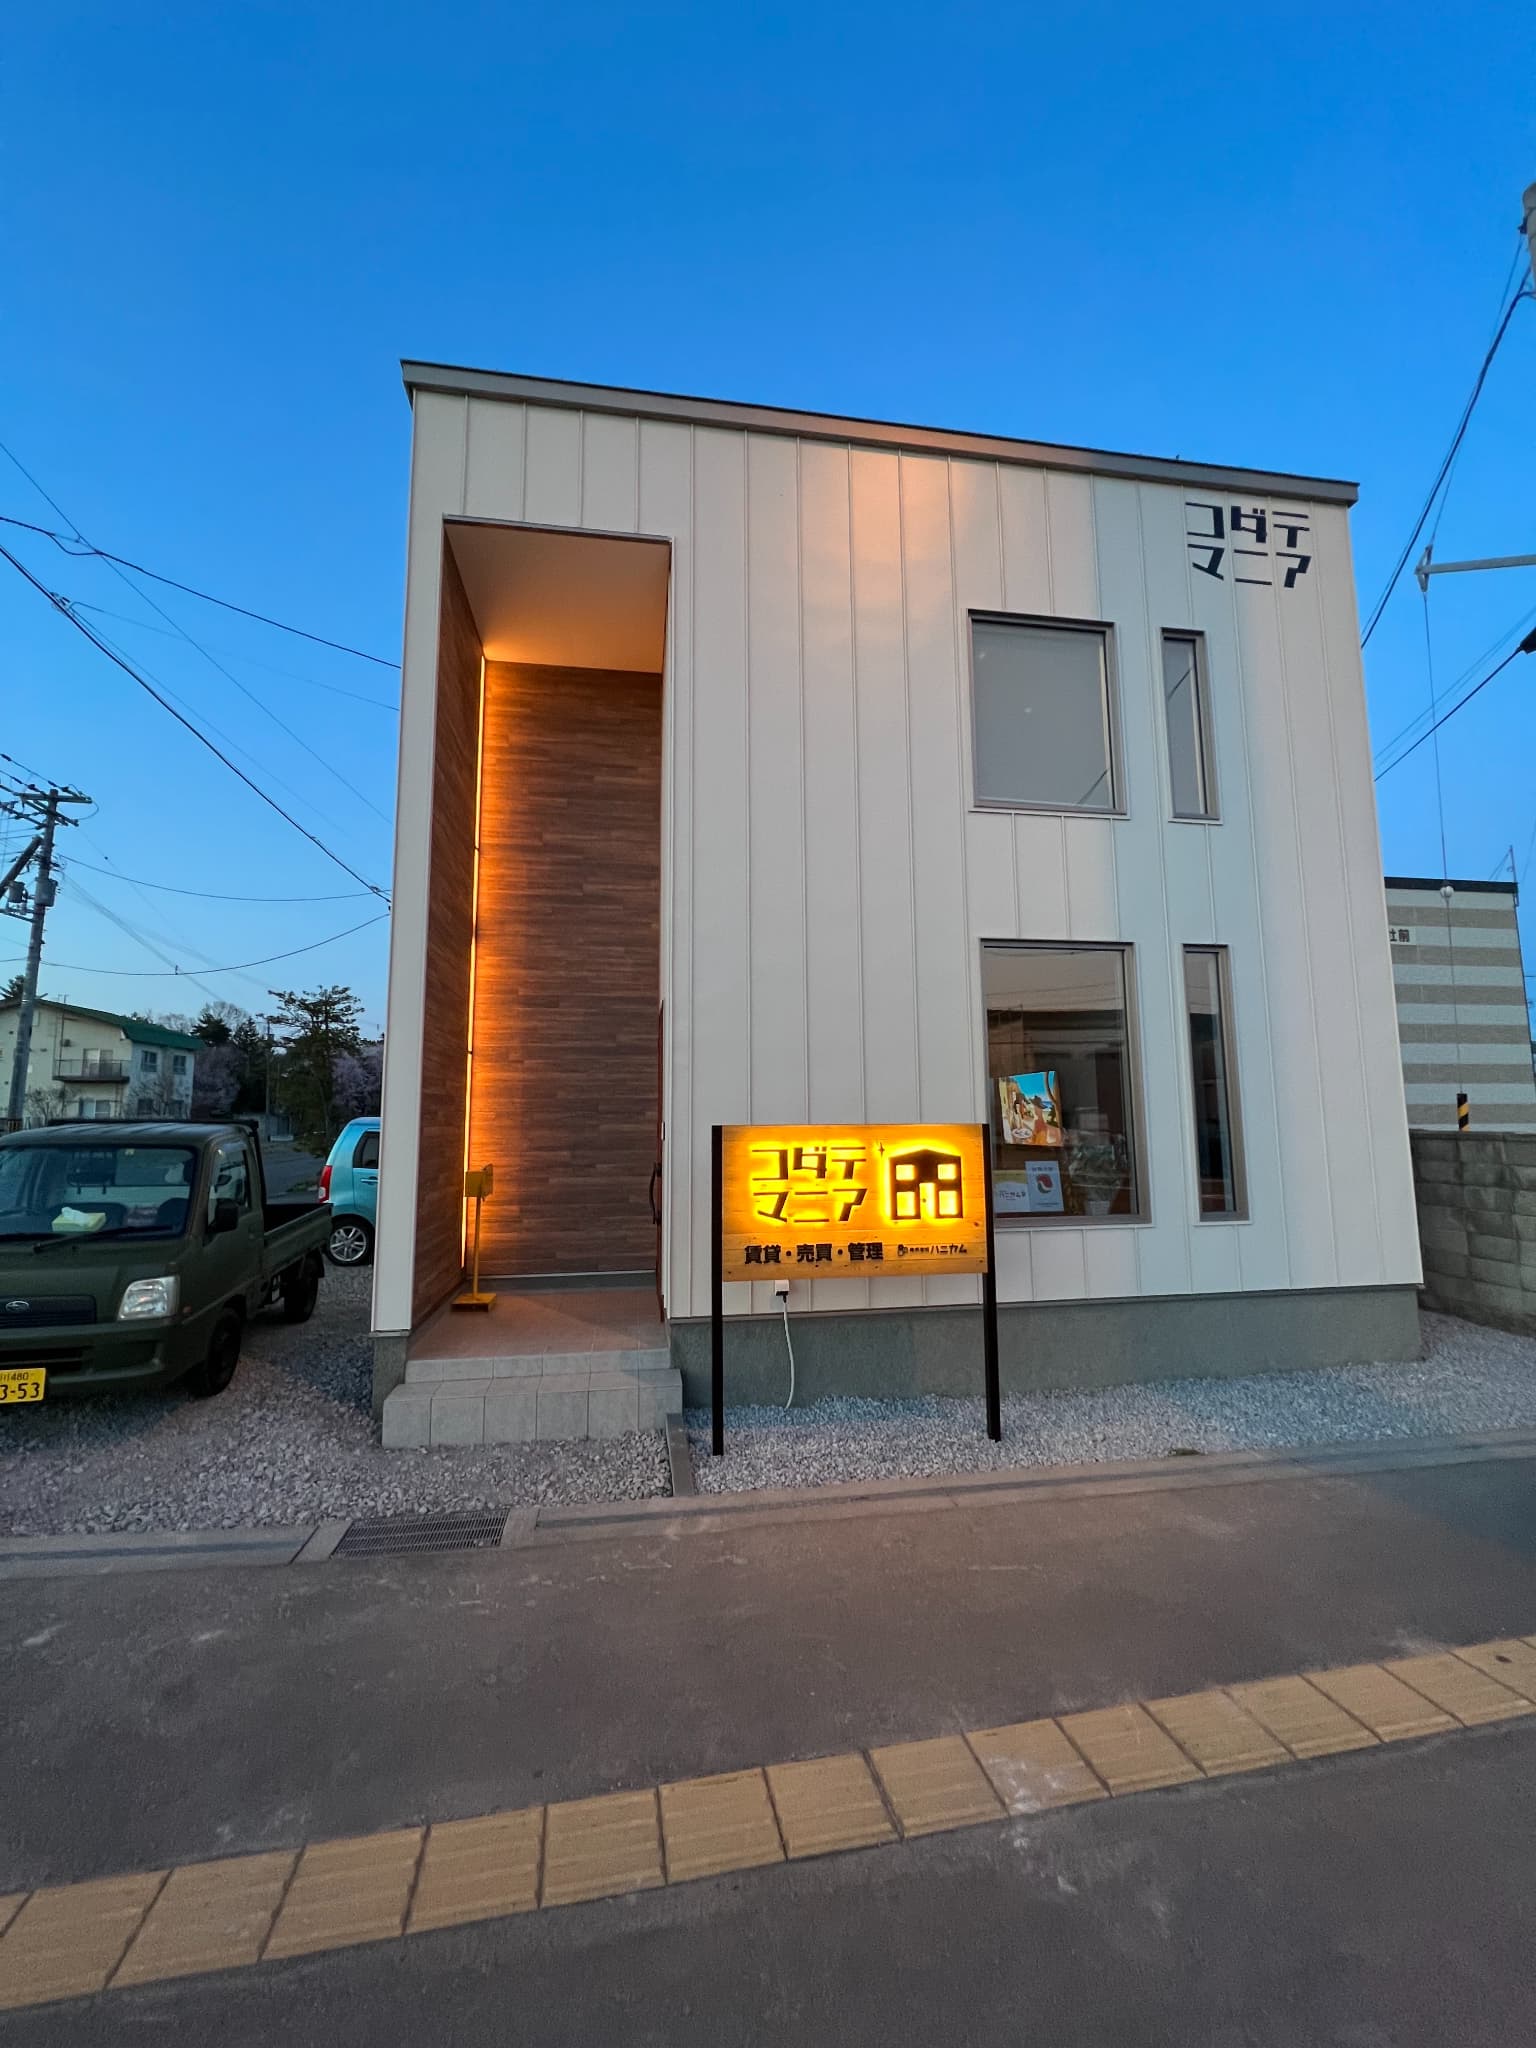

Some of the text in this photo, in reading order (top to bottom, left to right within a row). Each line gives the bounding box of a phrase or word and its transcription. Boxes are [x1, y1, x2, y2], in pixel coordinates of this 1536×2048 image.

[1185, 501, 1310, 548] コダテ
[1187, 543, 1312, 588] マニア
[751, 1146, 867, 1180] コダテ
[752, 1187, 868, 1223] マニア
[744, 1242, 883, 1265] 賃貸・売買・管理
